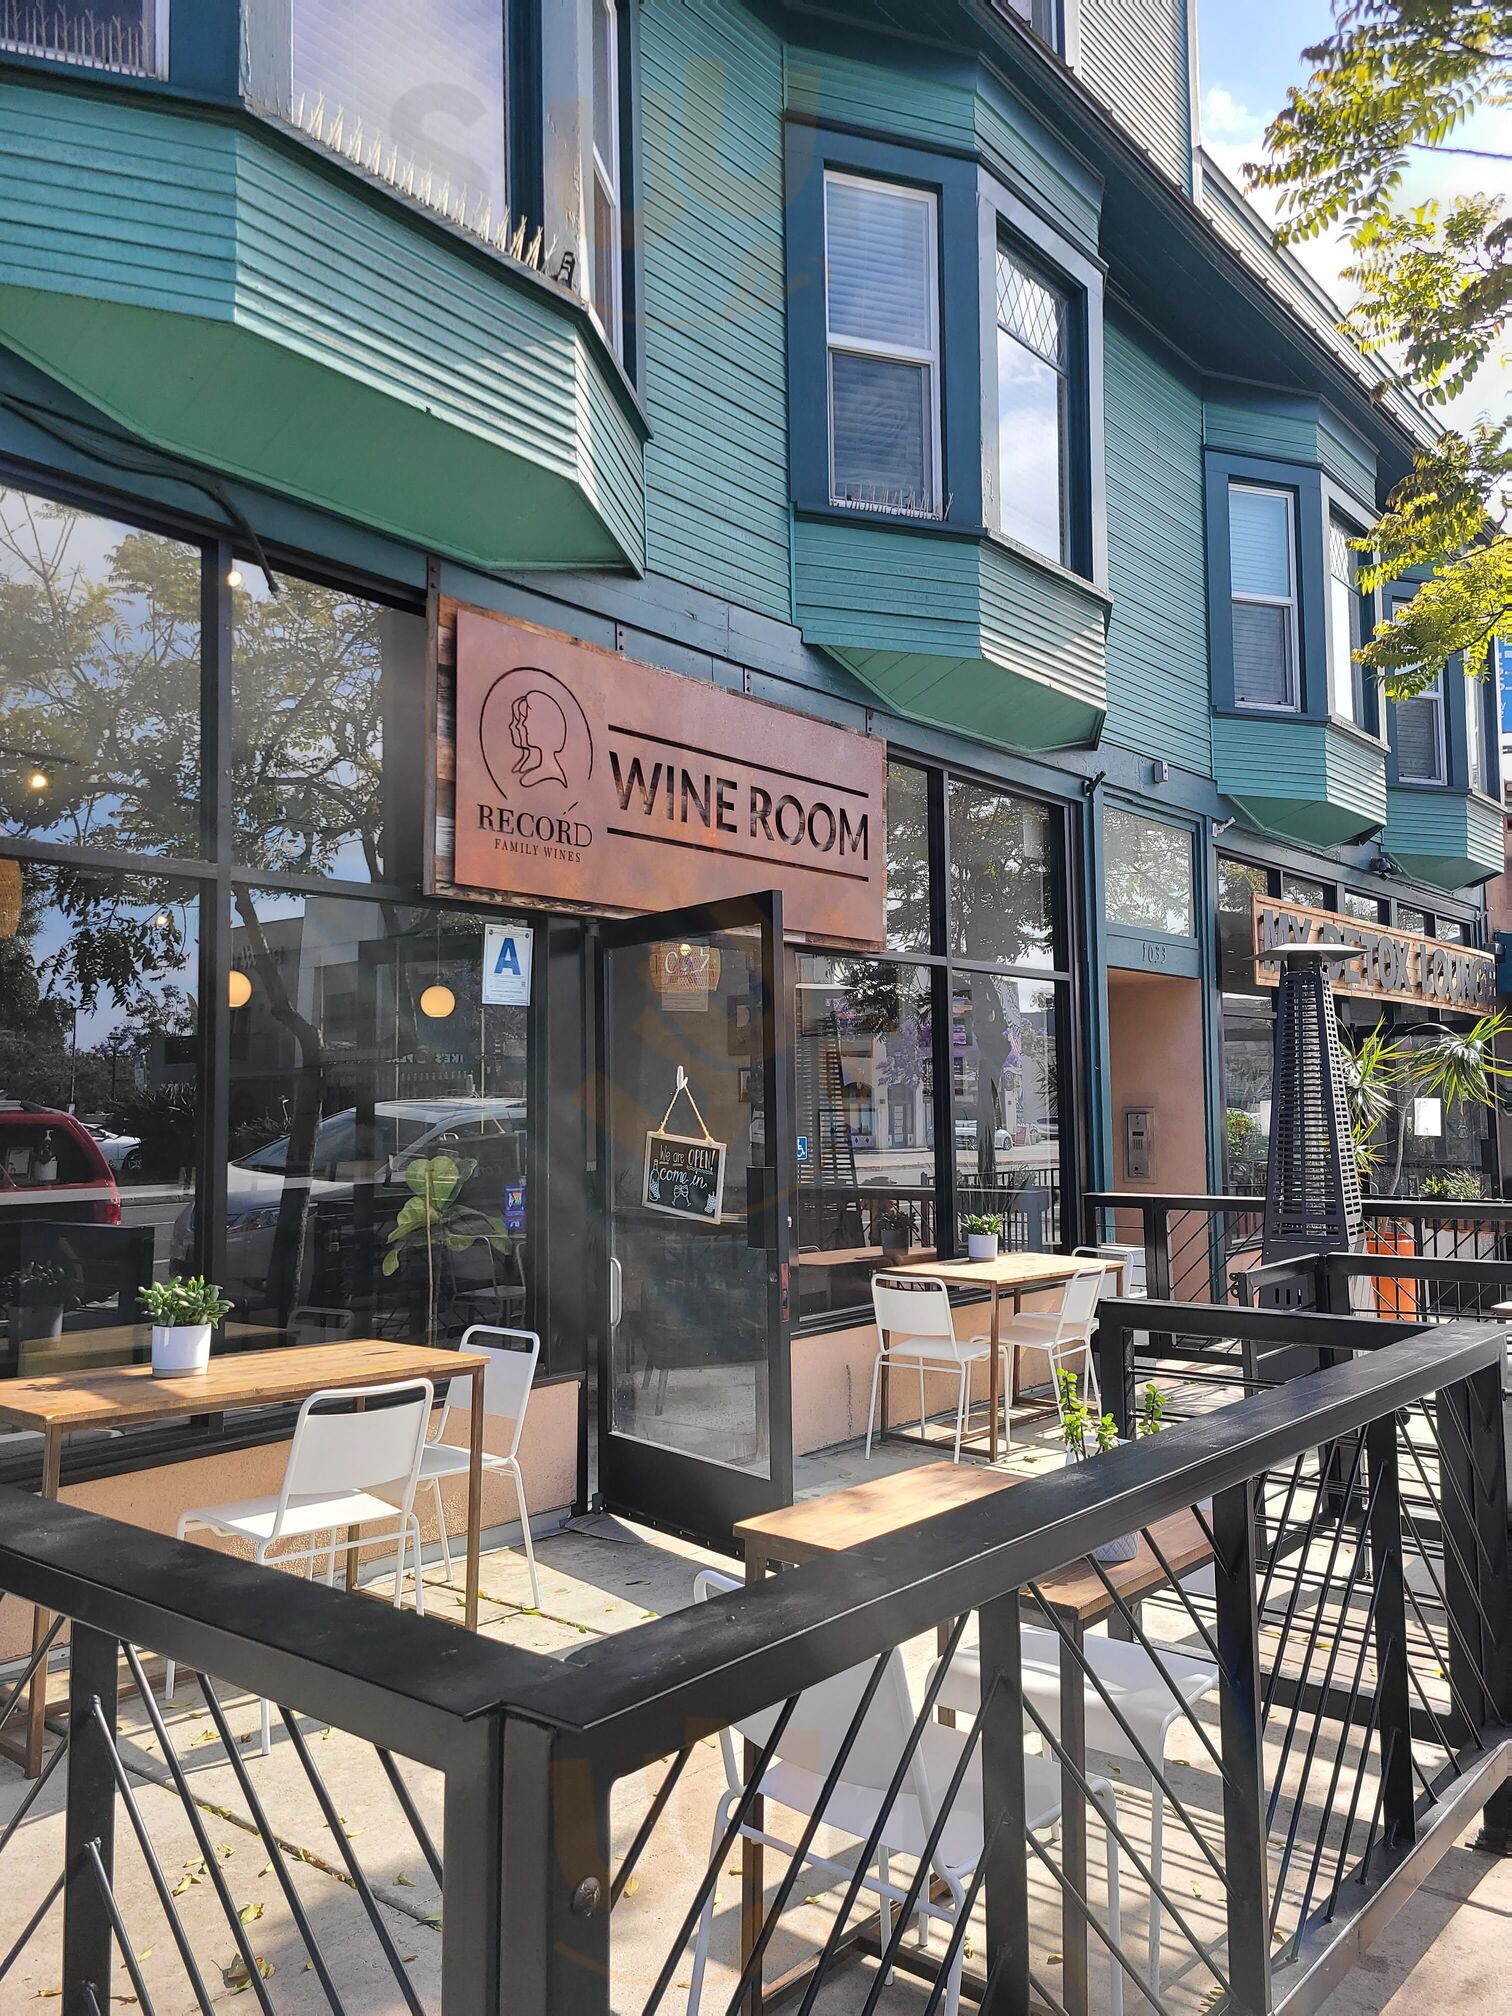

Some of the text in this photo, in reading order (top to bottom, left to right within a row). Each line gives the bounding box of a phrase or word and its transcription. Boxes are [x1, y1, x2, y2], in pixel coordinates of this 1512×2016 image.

[477, 803, 593, 848] RECORD
[609, 751, 869, 861] WINE ROOM
[495, 838, 582, 863] FAMILY WINES
[494, 937, 521, 976] A
[1142, 942, 1167, 965] 1033
[1321, 922, 1413, 992] DETOX
[1417, 943, 1497, 1004] LOUNGE
[660, 1144, 716, 1171] We are OPEN!
